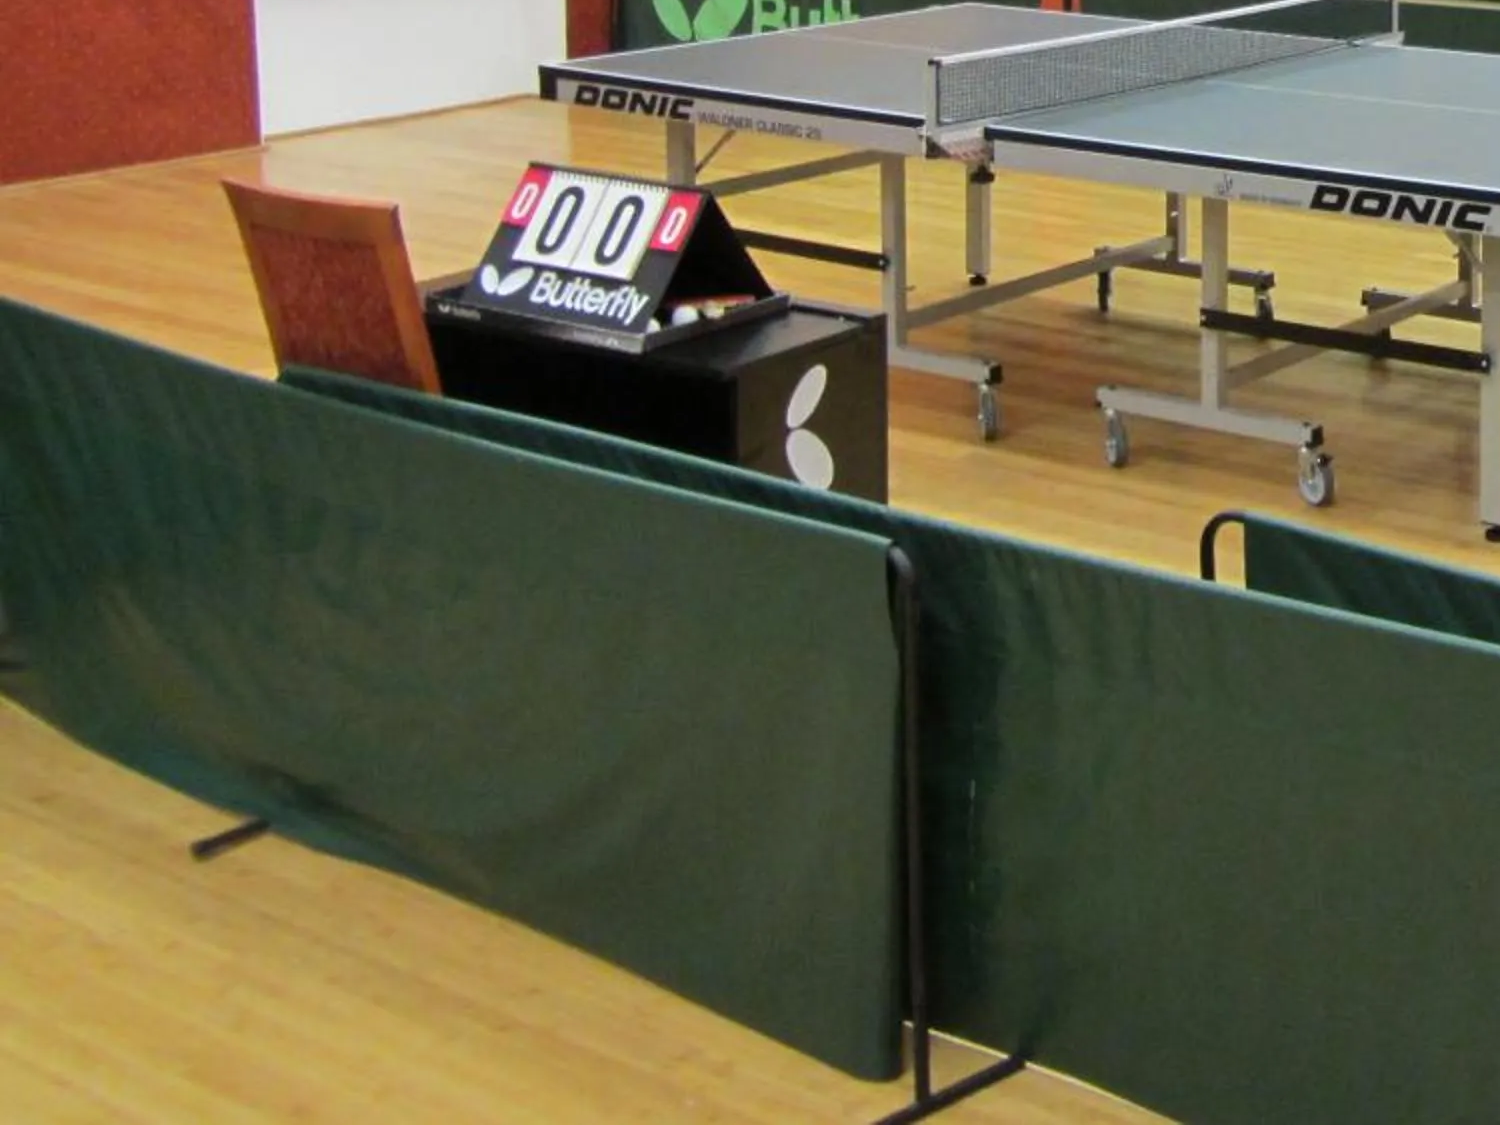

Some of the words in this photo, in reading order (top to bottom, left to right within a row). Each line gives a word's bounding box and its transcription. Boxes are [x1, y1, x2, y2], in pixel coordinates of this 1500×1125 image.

[573, 83, 694, 121] DONIC
[535, 185, 586, 256] 0
[594, 194, 645, 266] 0
[1309, 183, 1492, 232] DONIC
[529, 270, 650, 326] Butterfly
